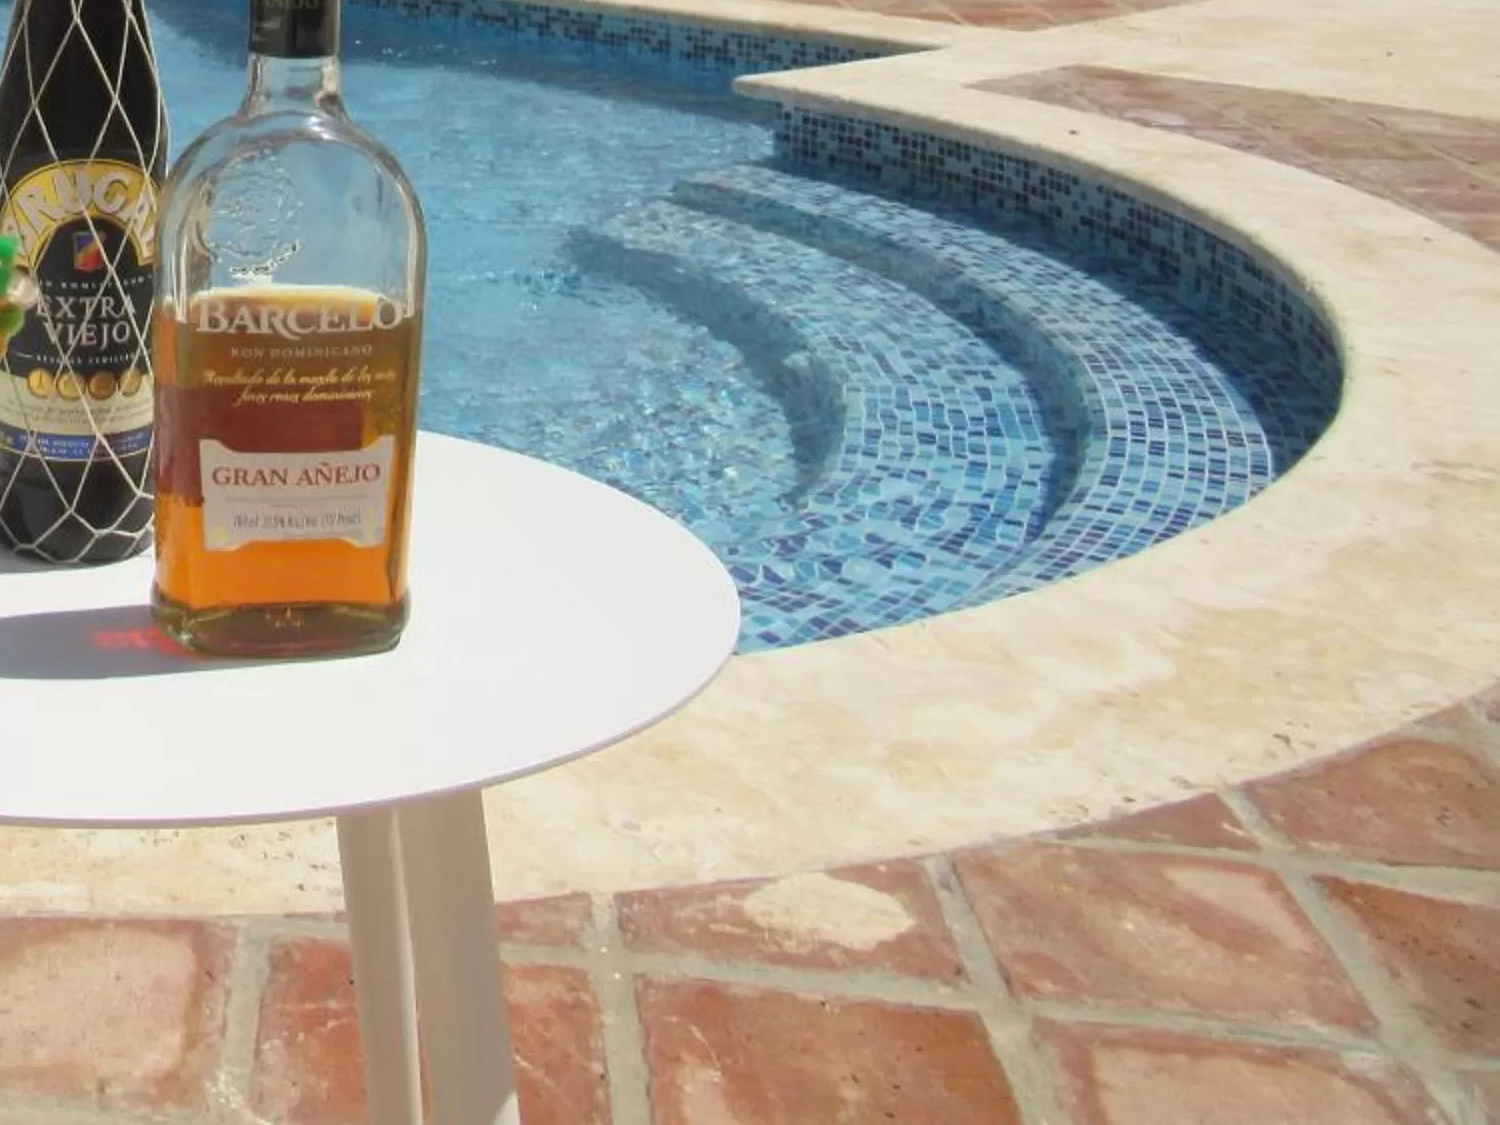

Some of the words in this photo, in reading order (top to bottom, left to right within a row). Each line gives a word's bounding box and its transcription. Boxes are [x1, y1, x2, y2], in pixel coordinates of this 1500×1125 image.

[36, 294, 137, 319] EXTRA
[43, 320, 131, 350] VIEJO
[211, 466, 289, 487] GRAN
[296, 461, 382, 487] AÑEJO
